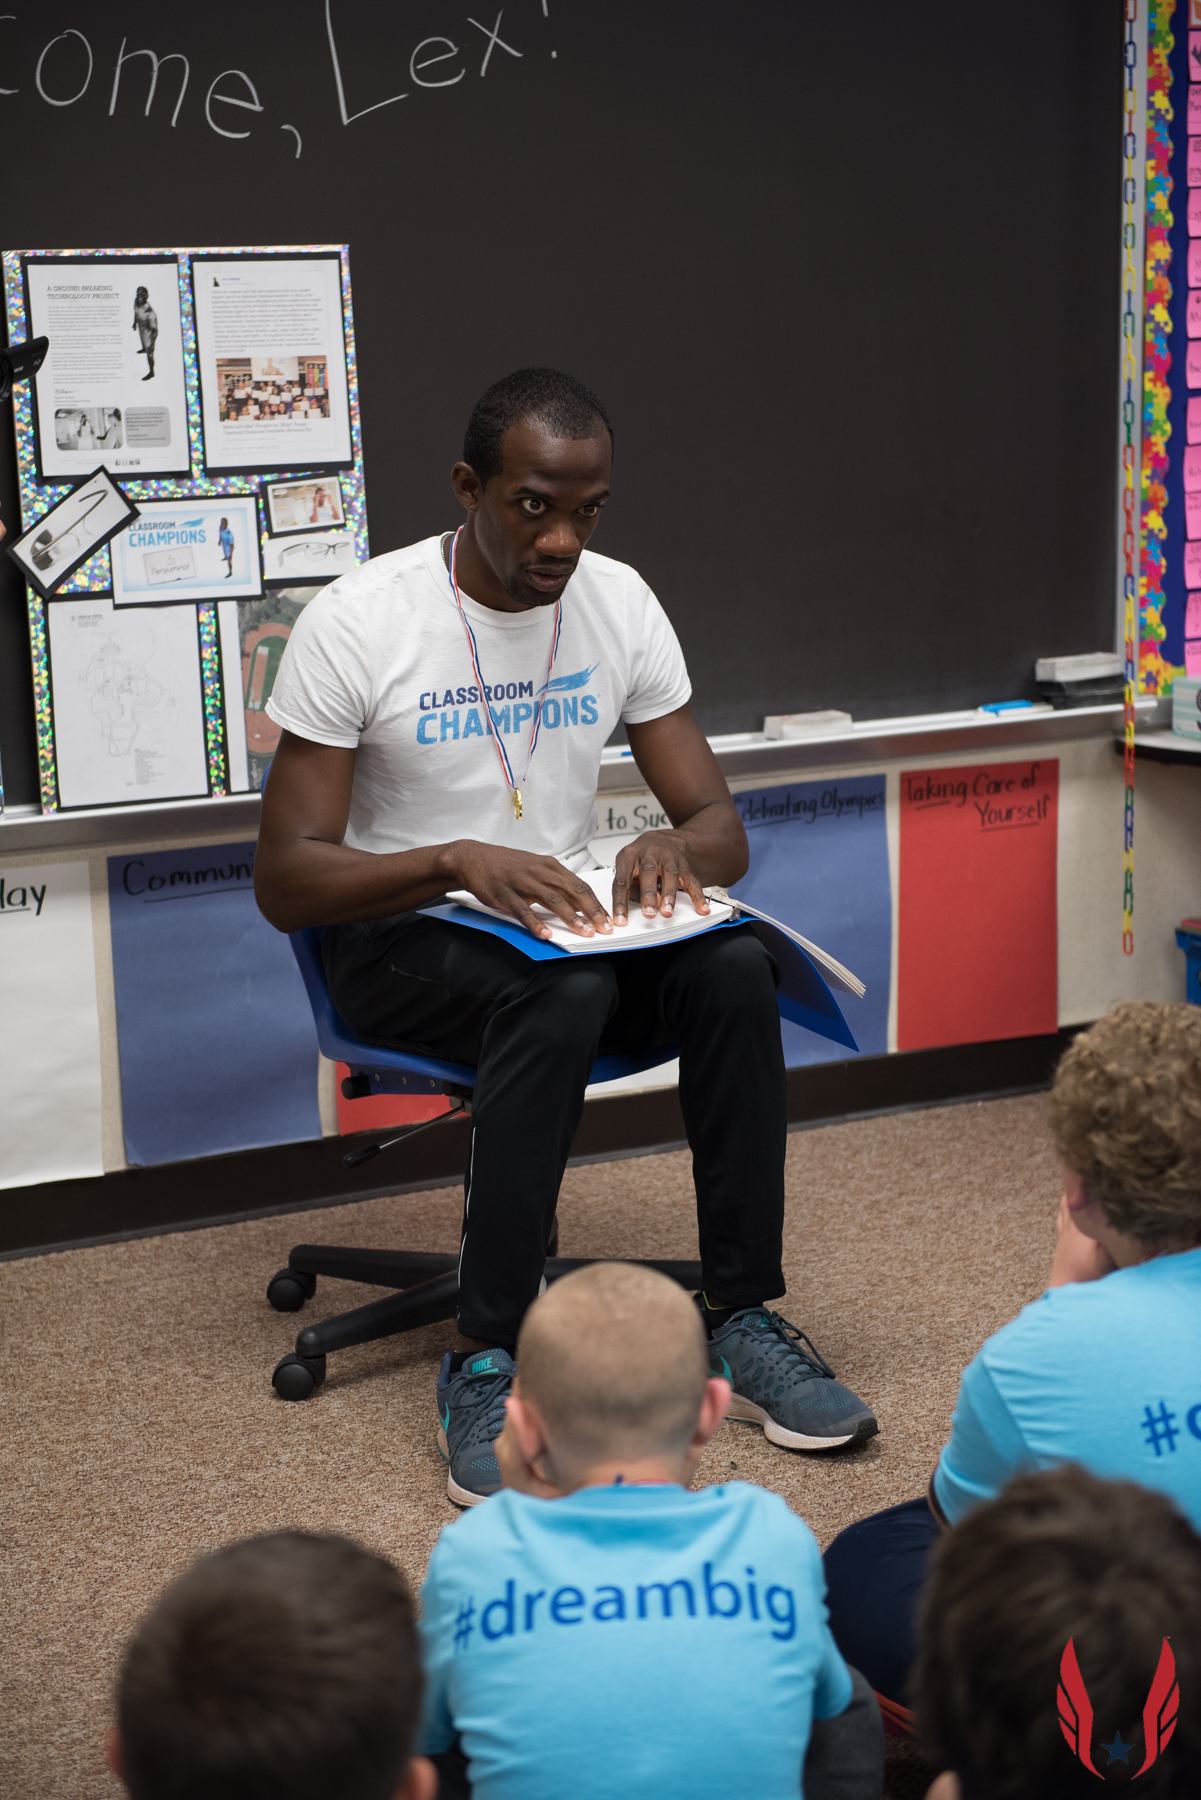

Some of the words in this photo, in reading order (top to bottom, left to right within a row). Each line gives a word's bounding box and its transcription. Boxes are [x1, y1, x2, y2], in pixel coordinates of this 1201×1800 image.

[129, 530, 206, 547] CHAMPIONS
[419, 680, 534, 711] CLASSROOM
[416, 695, 600, 745] CHAMPIONS
[904, 776, 968, 807] Taking
[972, 772, 1016, 797] Care
[1021, 762, 1040, 789] of
[606, 806, 628, 830] to
[974, 794, 1050, 827] Yourself
[472, 1357, 493, 1375] NIKE
[452, 1562, 797, 1651] #dreambig
